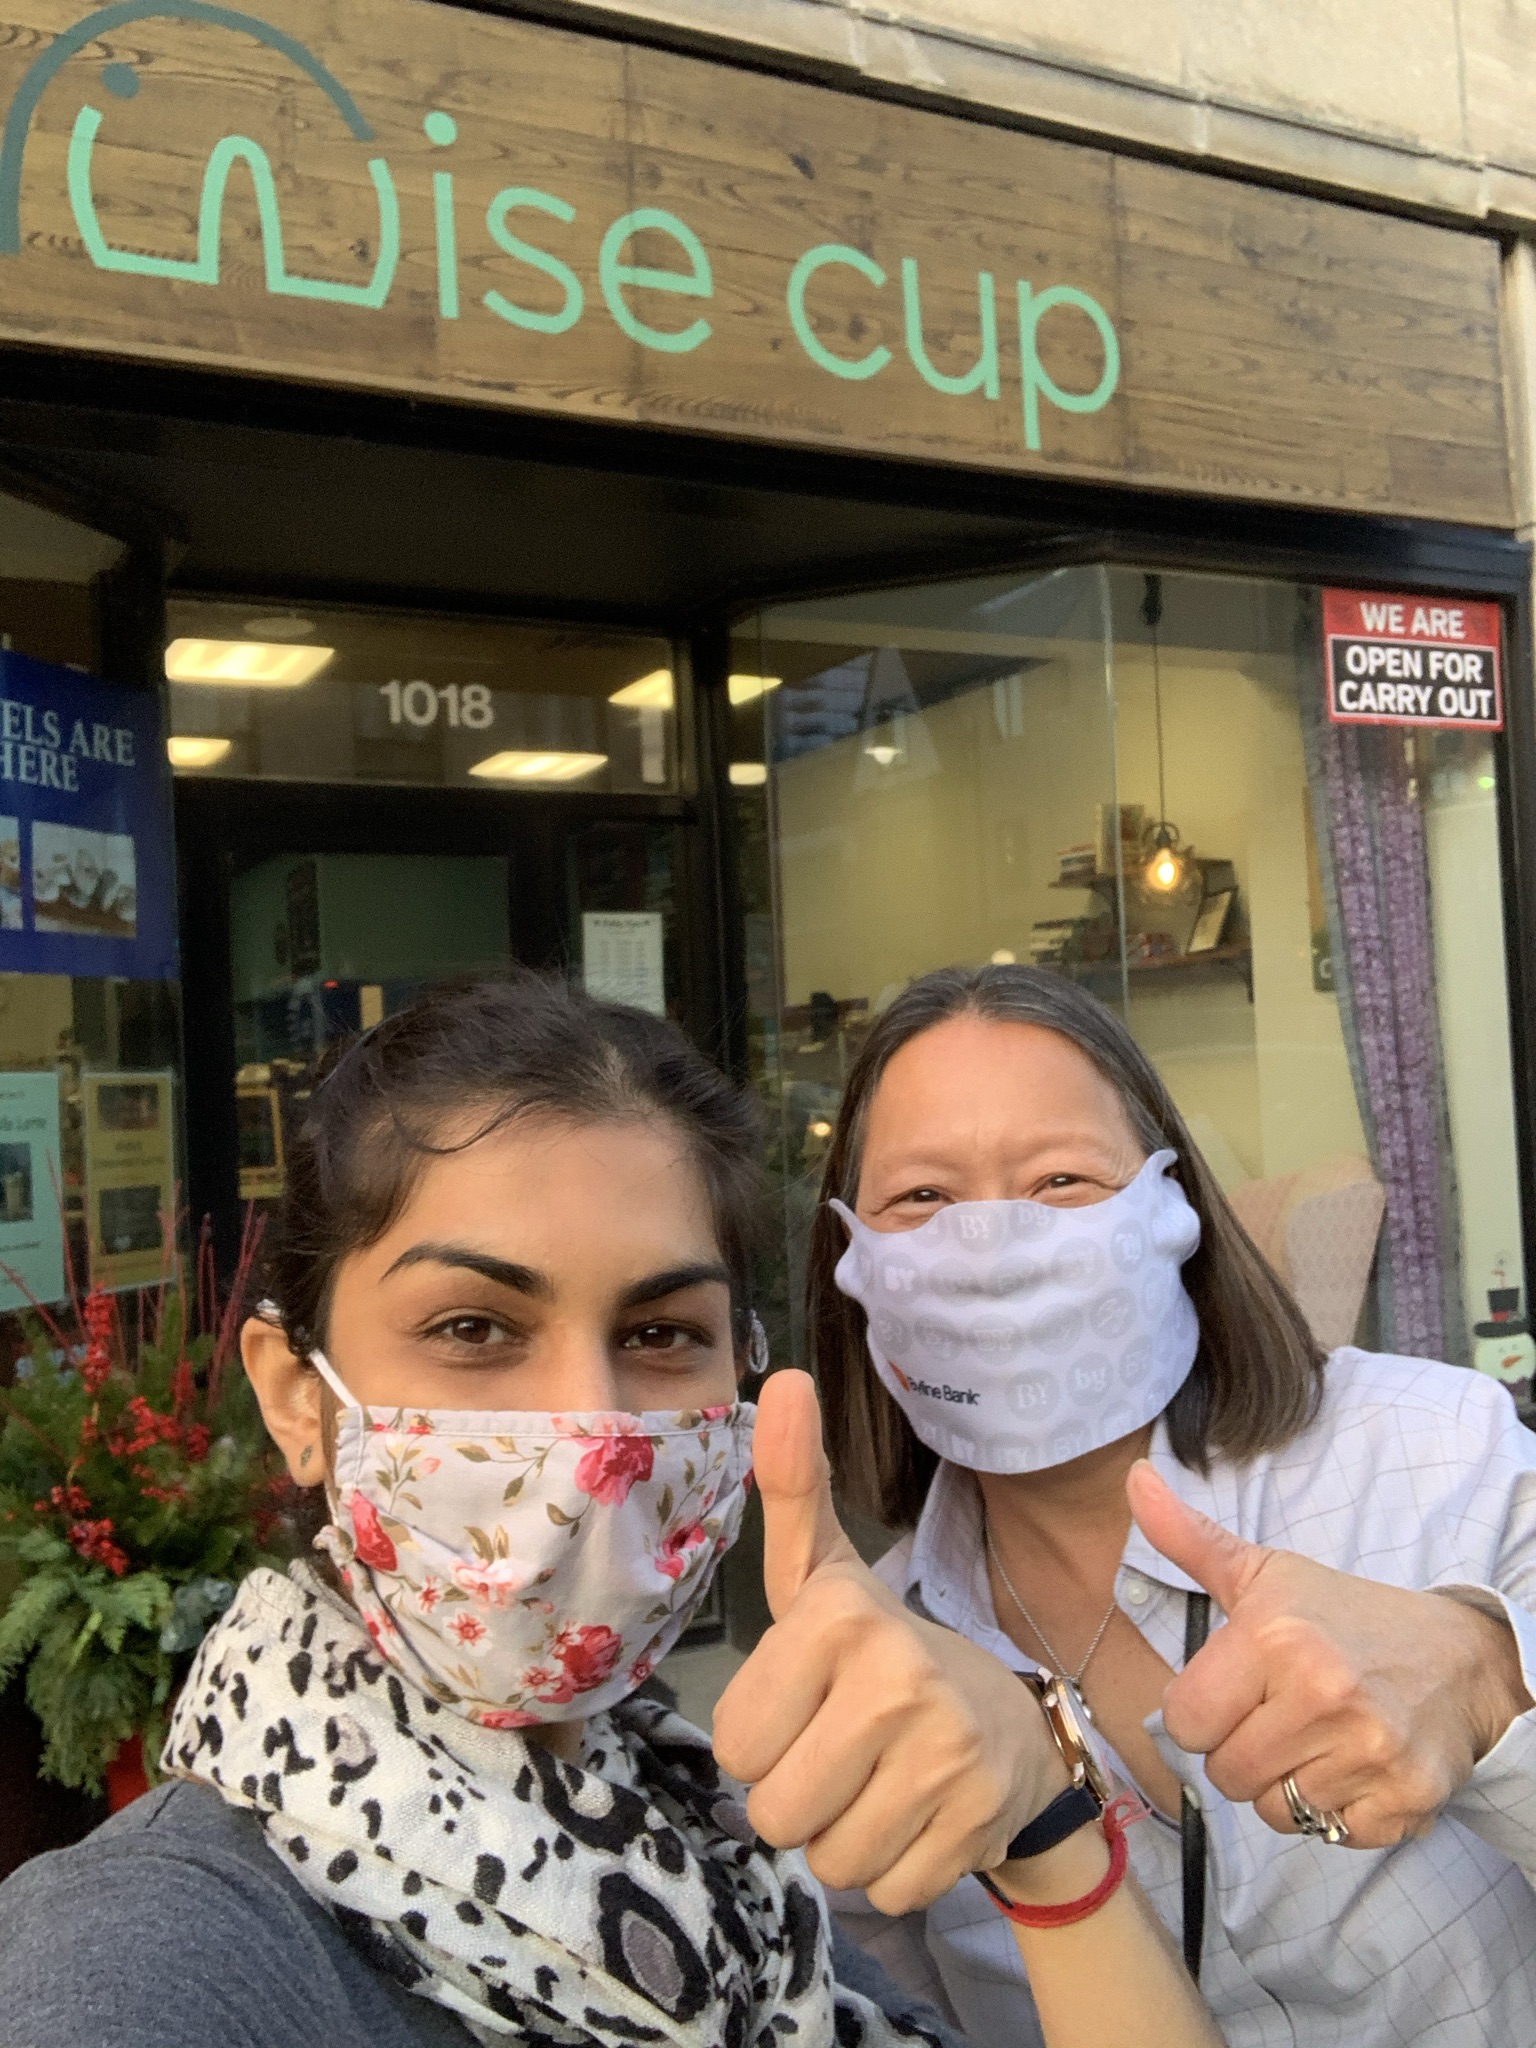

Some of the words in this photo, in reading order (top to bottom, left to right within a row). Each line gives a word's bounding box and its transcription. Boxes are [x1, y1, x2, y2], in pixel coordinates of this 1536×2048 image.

[67, 104, 713, 353] wise
[786, 243, 1121, 451] cup
[1359, 601, 1405, 634] WE
[1410, 607, 1466, 640] ARE
[1345, 645, 1423, 679] OPEN
[1428, 651, 1484, 684] FOR
[379, 679, 495, 730] 1018
[1338, 680, 1433, 714] CARRY
[1438, 686, 1493, 718] OUT
[69, 719, 136, 767] ARE
